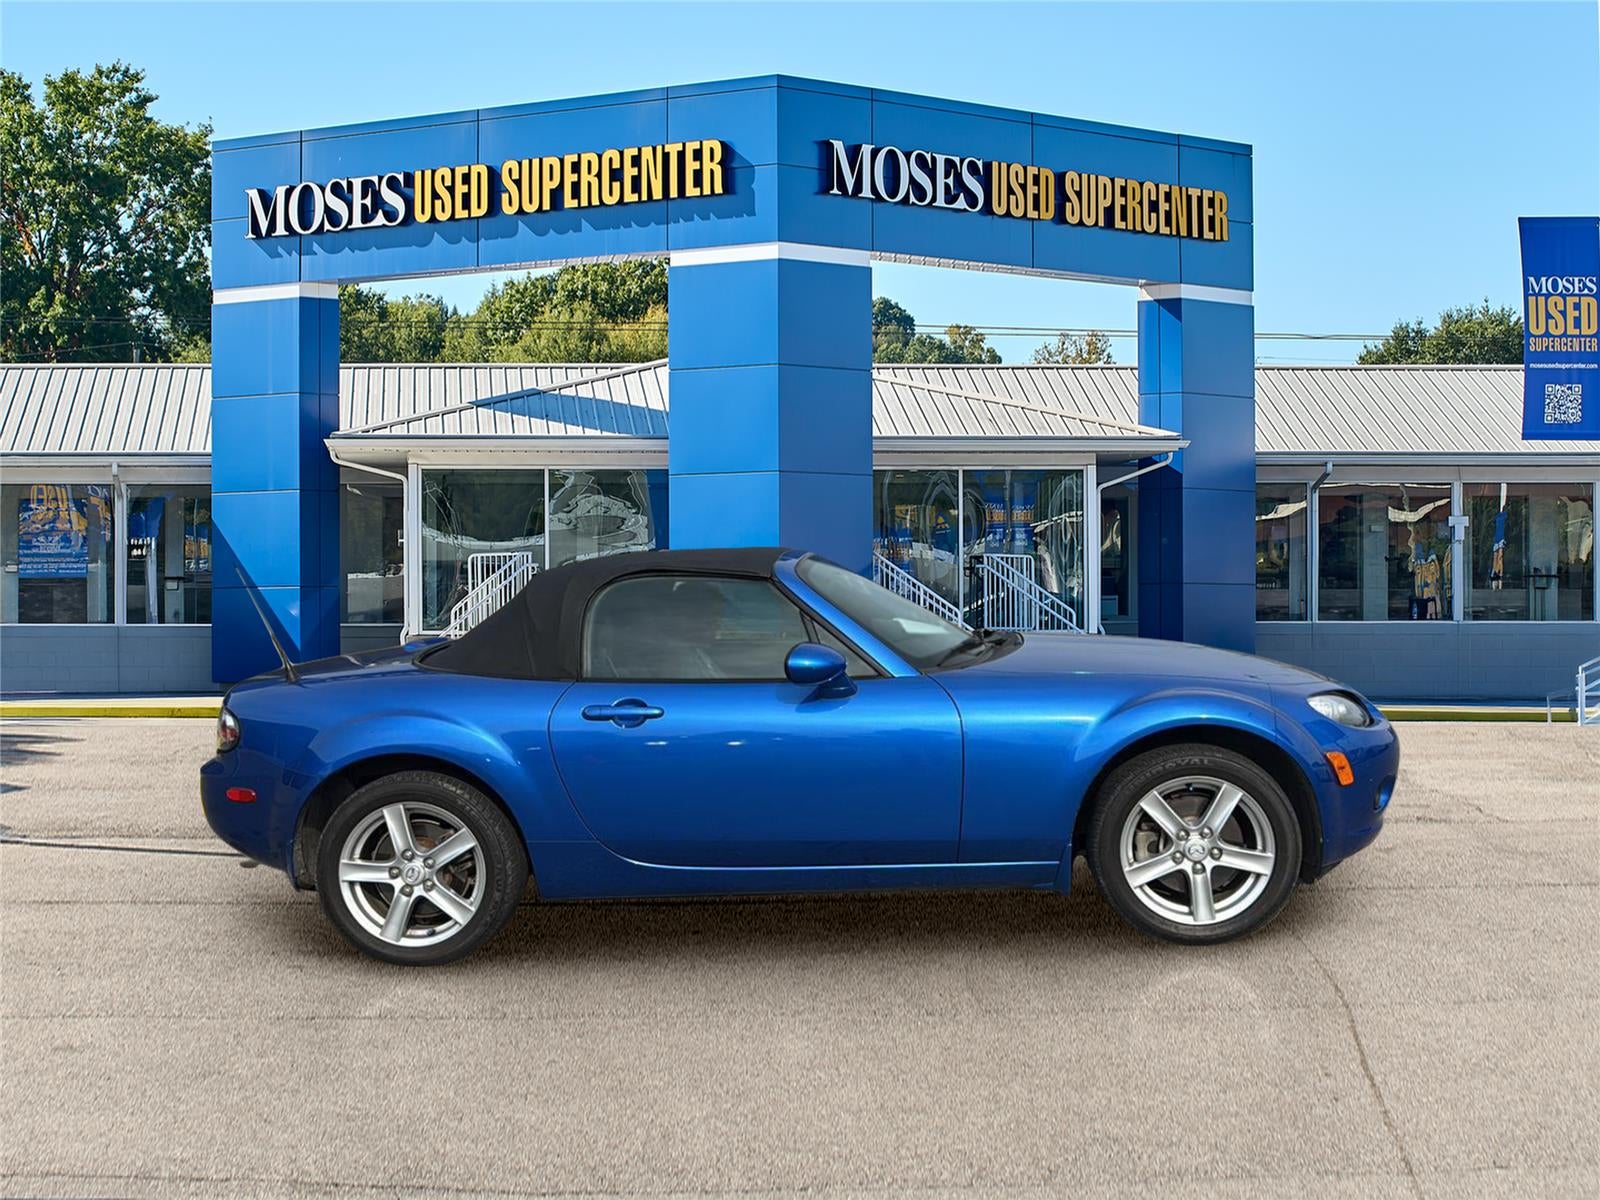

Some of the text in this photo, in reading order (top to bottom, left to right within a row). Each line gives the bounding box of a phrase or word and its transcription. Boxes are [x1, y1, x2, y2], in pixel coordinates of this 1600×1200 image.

[244, 139, 724, 240] MOSES USED SUPERCENTER
[828, 138, 1229, 242] MOSES USED SUPERCENTER
[1527, 276, 1597, 295] MOSES
[1528, 295, 1598, 336] USED
[1529, 337, 1598, 352] SUPERCENTER
